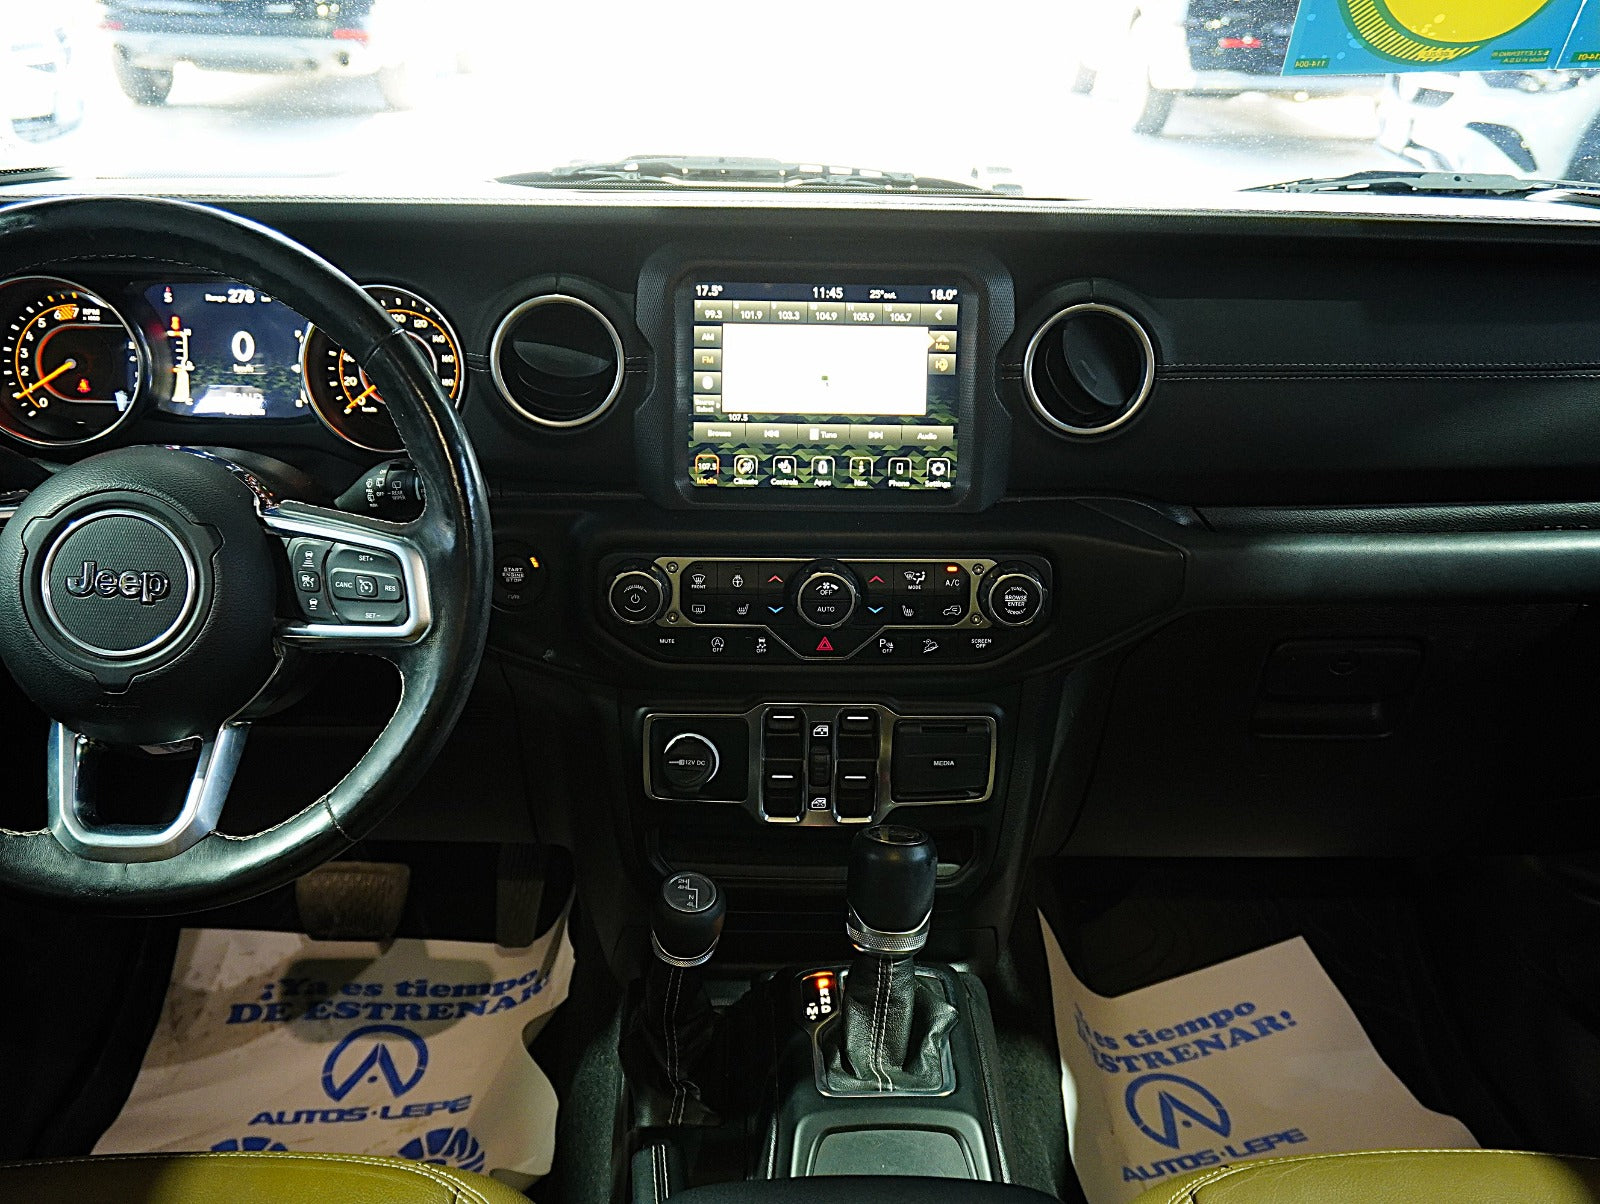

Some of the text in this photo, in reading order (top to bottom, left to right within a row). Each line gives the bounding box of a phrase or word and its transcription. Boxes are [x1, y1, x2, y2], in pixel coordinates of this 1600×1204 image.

[812, 286, 844, 299] 11:45
[53, 309, 61, 320] 6
[37, 317, 47, 328] 5
[25, 330, 34, 342] 4
[701, 333, 715, 341] AM
[231, 330, 255, 362] 0
[19, 347, 29, 359] 3
[701, 356, 715, 364] FM
[20, 365, 29, 377] 2
[343, 375, 358, 387] 20
[38, 397, 49, 408] 0
[65, 560, 171, 607] Jeep
[335, 581, 353, 589] CANC
[945, 579, 960, 587] A/C
[816, 605, 835, 613] AUTO
[341, 982, 384, 998] es
[395, 968, 539, 999] tiempo
[225, 974, 548, 1025] DE ESTRENAR
[820, 1004, 832, 1014] D
[1123, 1001, 1257, 1049] tiempo
